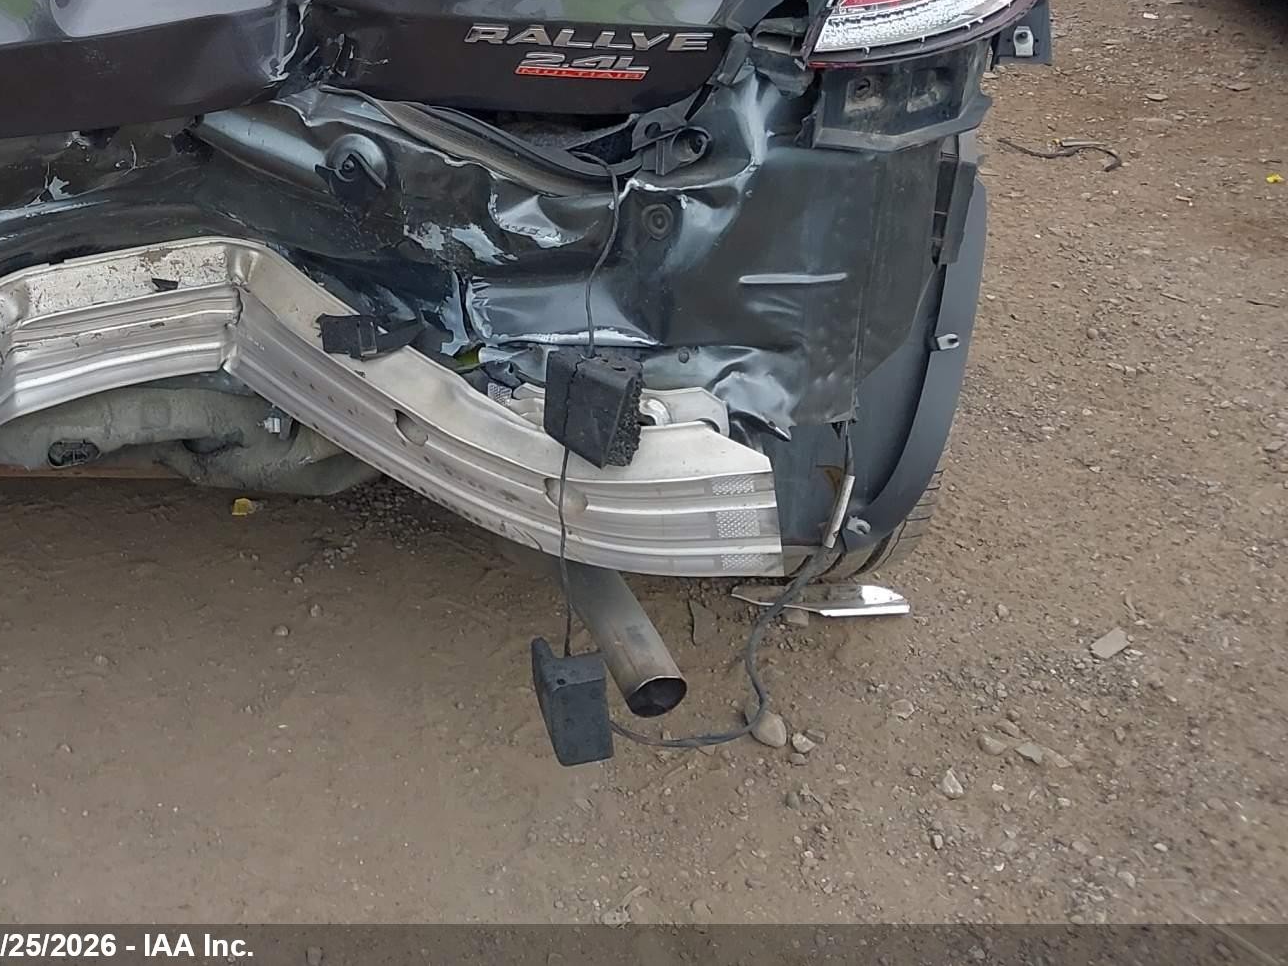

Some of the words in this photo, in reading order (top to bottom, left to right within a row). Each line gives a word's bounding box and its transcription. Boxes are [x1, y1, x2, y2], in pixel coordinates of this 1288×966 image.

[464, 22, 714, 52] RALLYE
[519, 51, 651, 71] 2.4L
[518, 66, 644, 80] MULTIAIR
